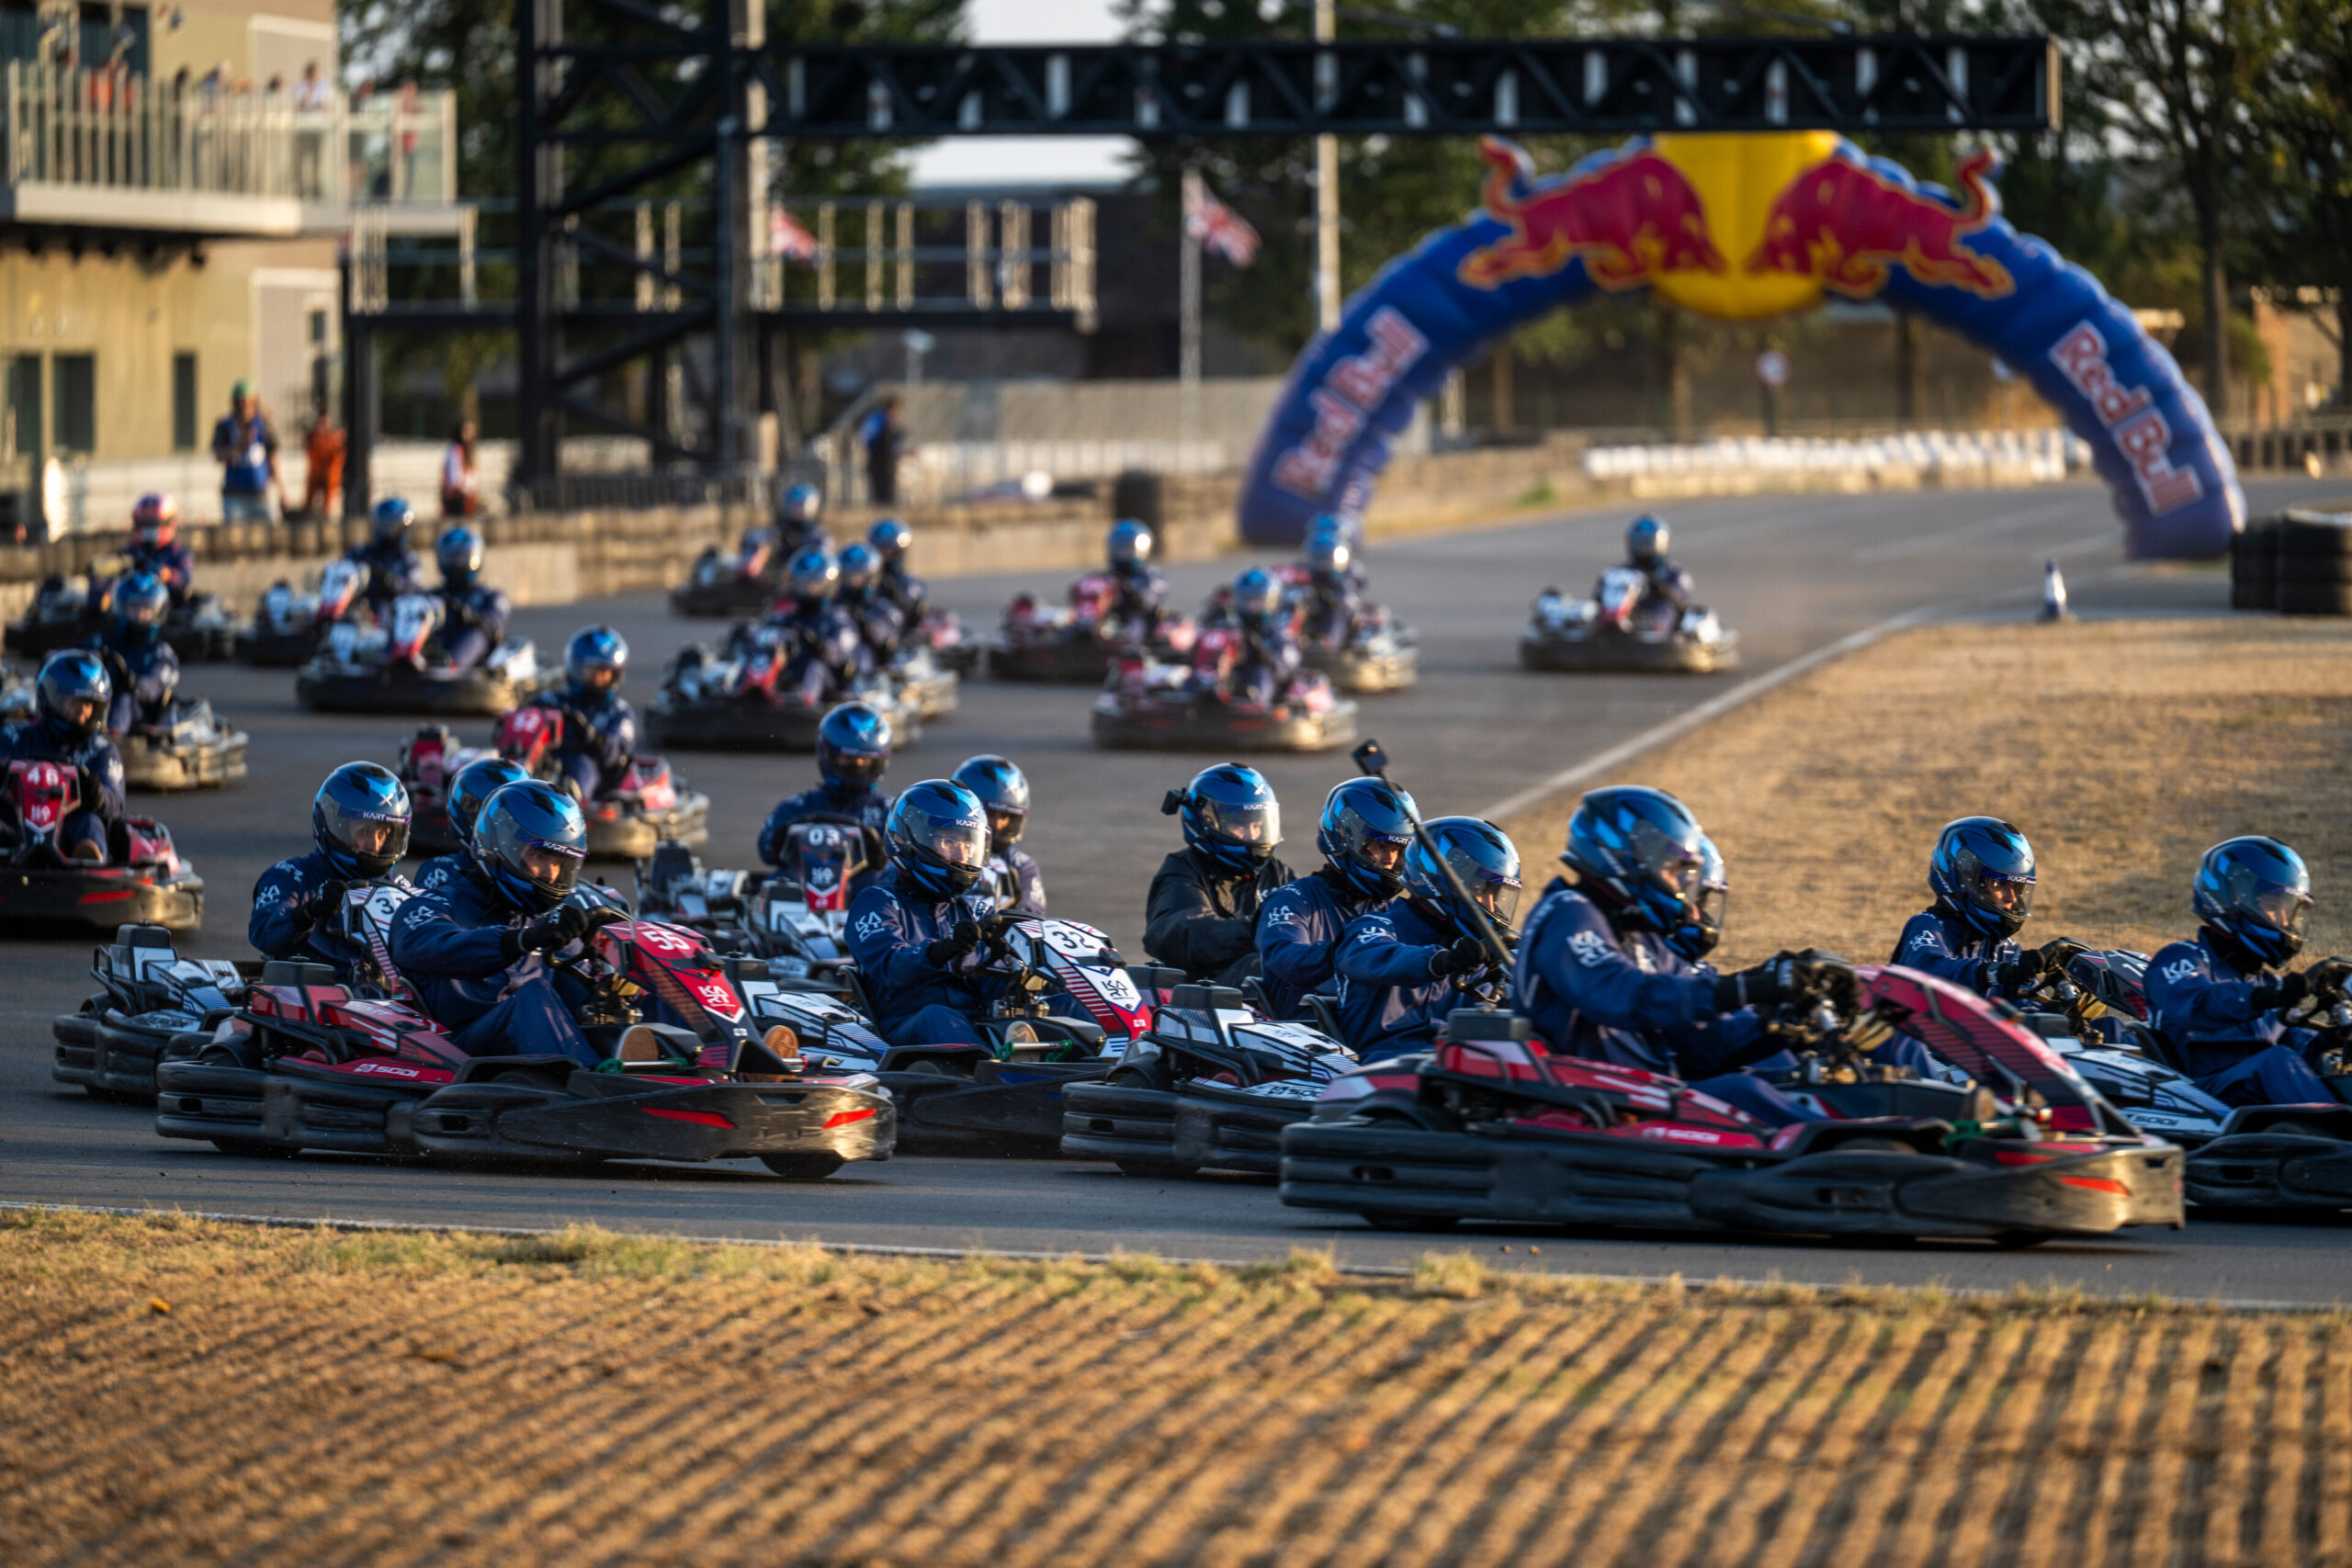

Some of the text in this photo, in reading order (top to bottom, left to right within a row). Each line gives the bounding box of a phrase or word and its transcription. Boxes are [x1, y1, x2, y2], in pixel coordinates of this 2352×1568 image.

[1270, 304, 1430, 501] Red Bull
[2049, 320, 2203, 516] Red Bull
[363, 811, 386, 821] KART
[956, 818, 978, 829] KART
[543, 840, 567, 854] KART
[1388, 835, 1409, 845] KART
[2007, 874, 2027, 884] KART
[574, 894, 603, 909] 11
[641, 931, 691, 951] 55
[1052, 931, 1096, 949] 32
[375, 1066, 421, 1077] SODI
